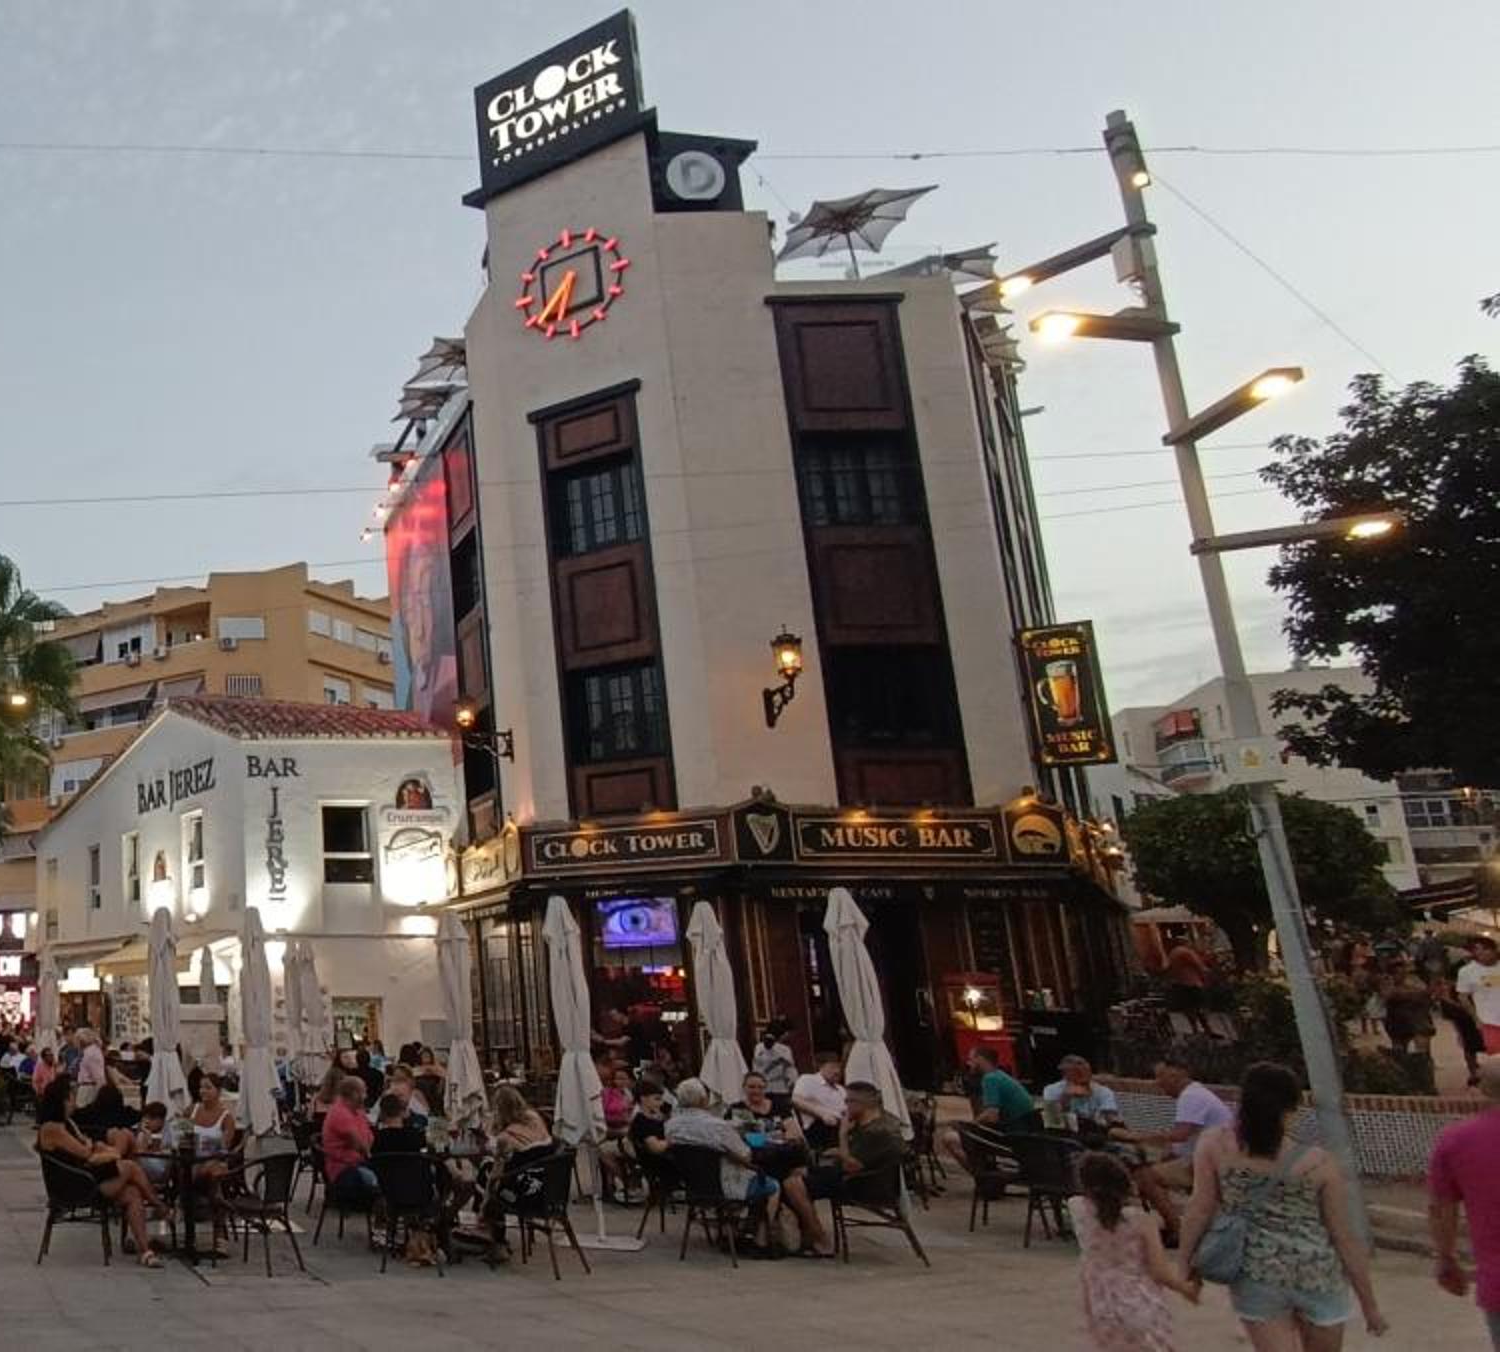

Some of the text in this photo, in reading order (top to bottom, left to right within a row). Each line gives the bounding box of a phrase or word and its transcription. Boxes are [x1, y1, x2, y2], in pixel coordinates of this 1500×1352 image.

[487, 40, 620, 122] CLOCK
[490, 72, 623, 151] TOWER
[493, 98, 627, 167] TORREMOLINOS
[1045, 729, 1096, 743] MUSIC
[1058, 741, 1092, 753] BAR
[246, 755, 301, 778] BAR
[137, 757, 216, 815] BAR JEREZ
[544, 832, 706, 859] CLOCK TOWER
[820, 827, 974, 848] MUSIC BAR
